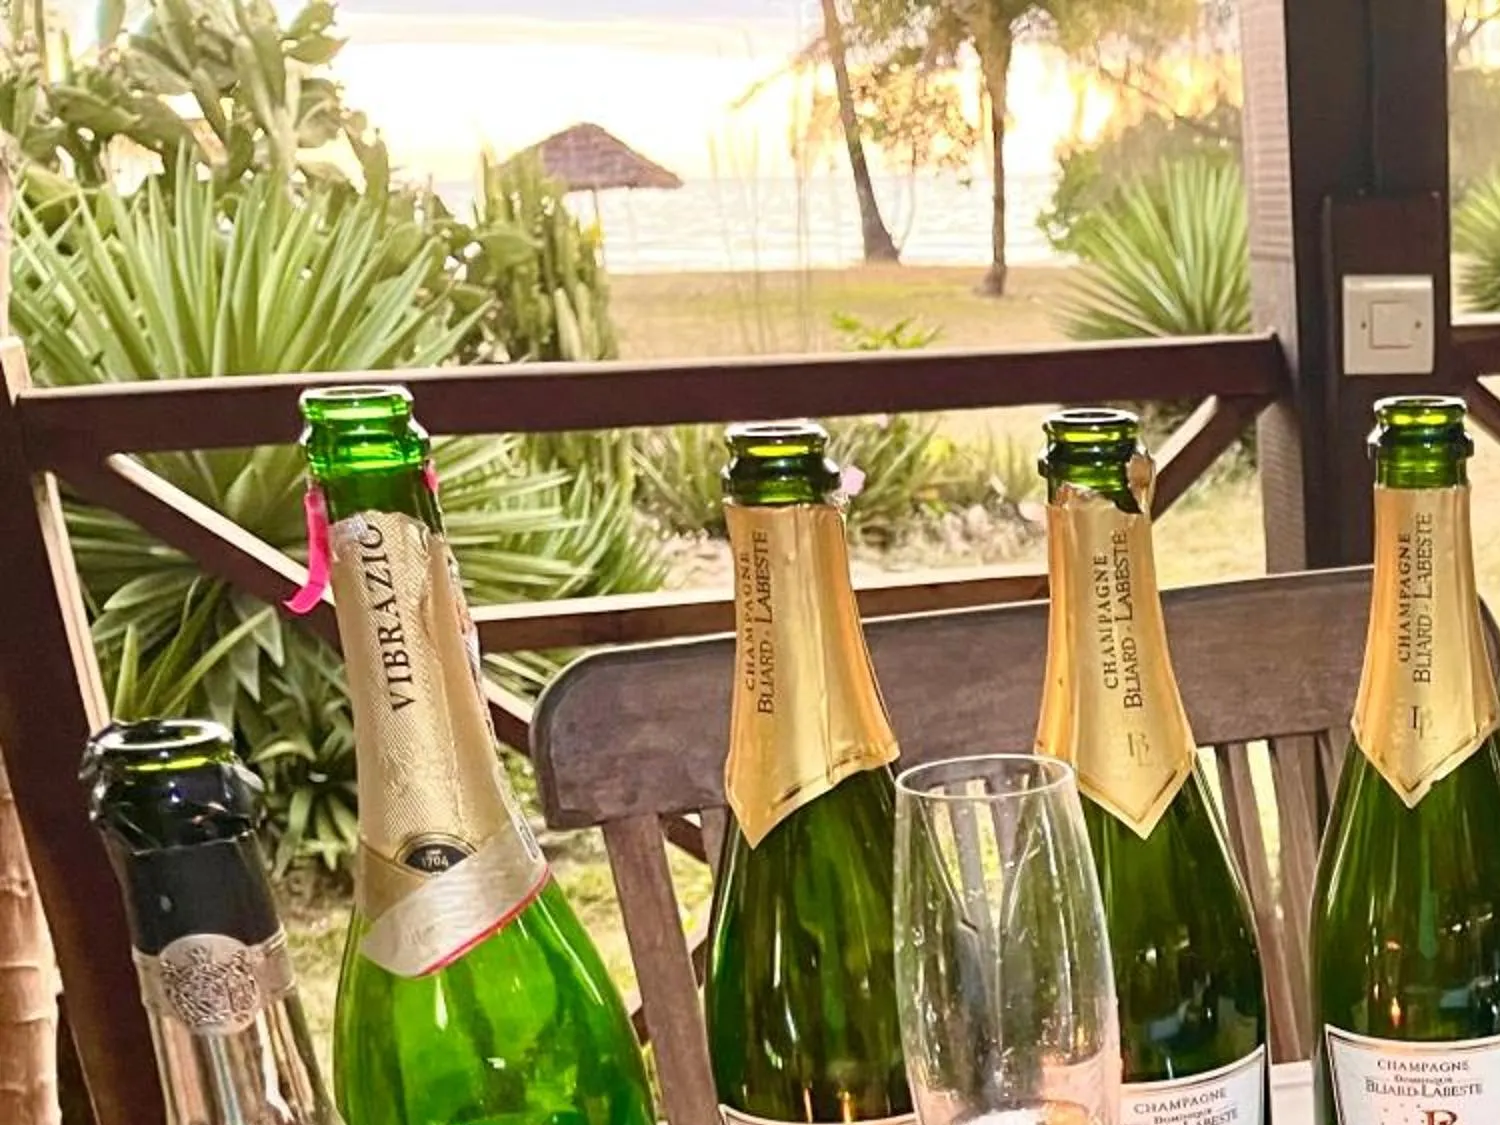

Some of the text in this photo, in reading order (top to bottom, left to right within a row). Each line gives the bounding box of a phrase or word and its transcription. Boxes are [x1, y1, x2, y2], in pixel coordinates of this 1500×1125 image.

[738, 552, 756, 692] CHAMPAGNE
[1093, 554, 1119, 690] CHAMPAGNE
[1397, 533, 1412, 663] CHAMPAGNE
[1133, 1087, 1228, 1115] CHAMPAGNE
[1377, 1059, 1470, 1073] CHAMPAGNE
